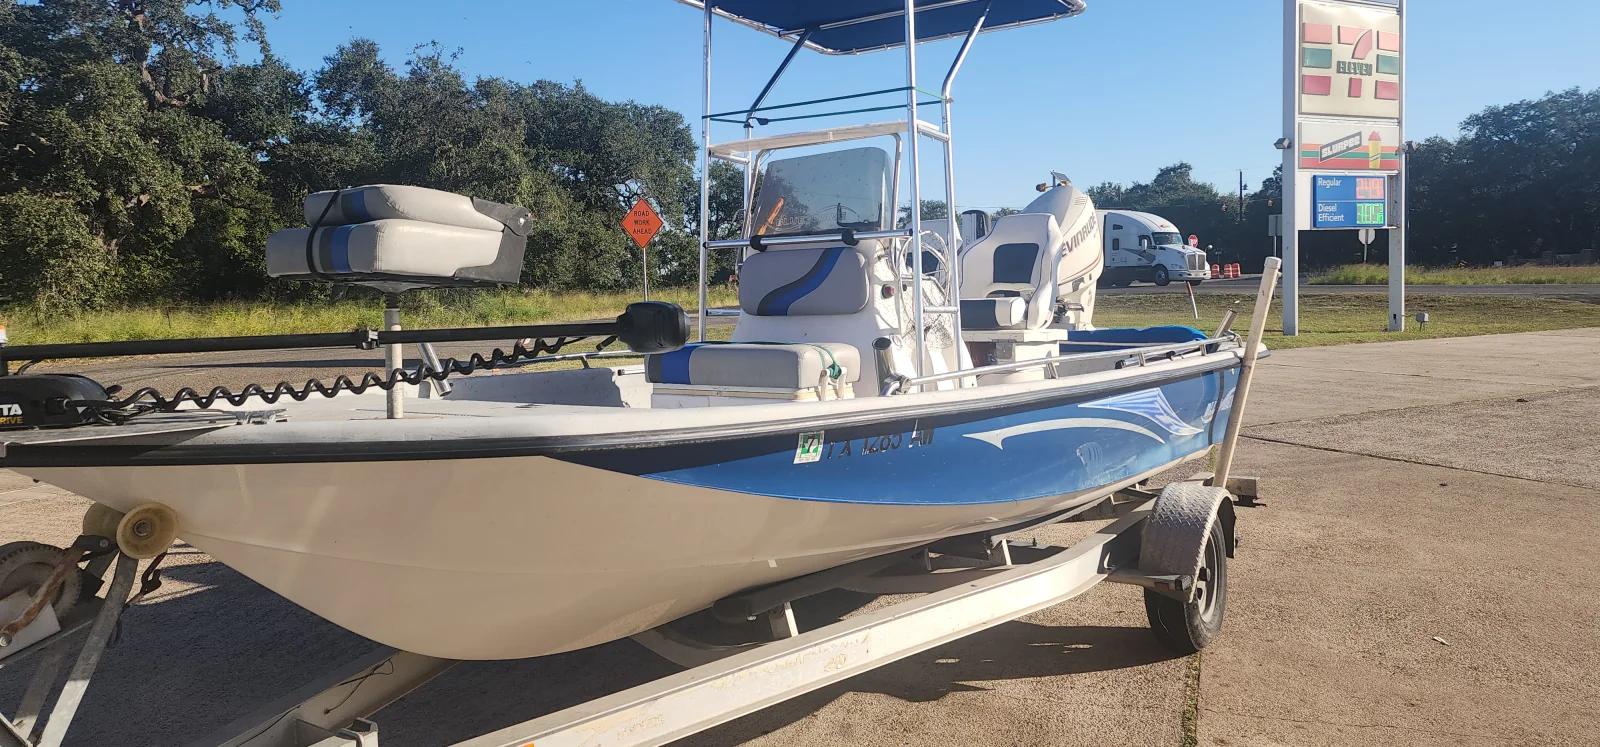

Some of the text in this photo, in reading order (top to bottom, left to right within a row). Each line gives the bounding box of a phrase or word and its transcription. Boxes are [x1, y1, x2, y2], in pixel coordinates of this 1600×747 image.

[1336, 60, 1372, 76] ELEVEN
[1321, 134, 1361, 159] SLURPEE
[1317, 177, 1342, 188] Regular
[1317, 203, 1337, 212] Diesel
[1317, 213, 1345, 222] Efficient
